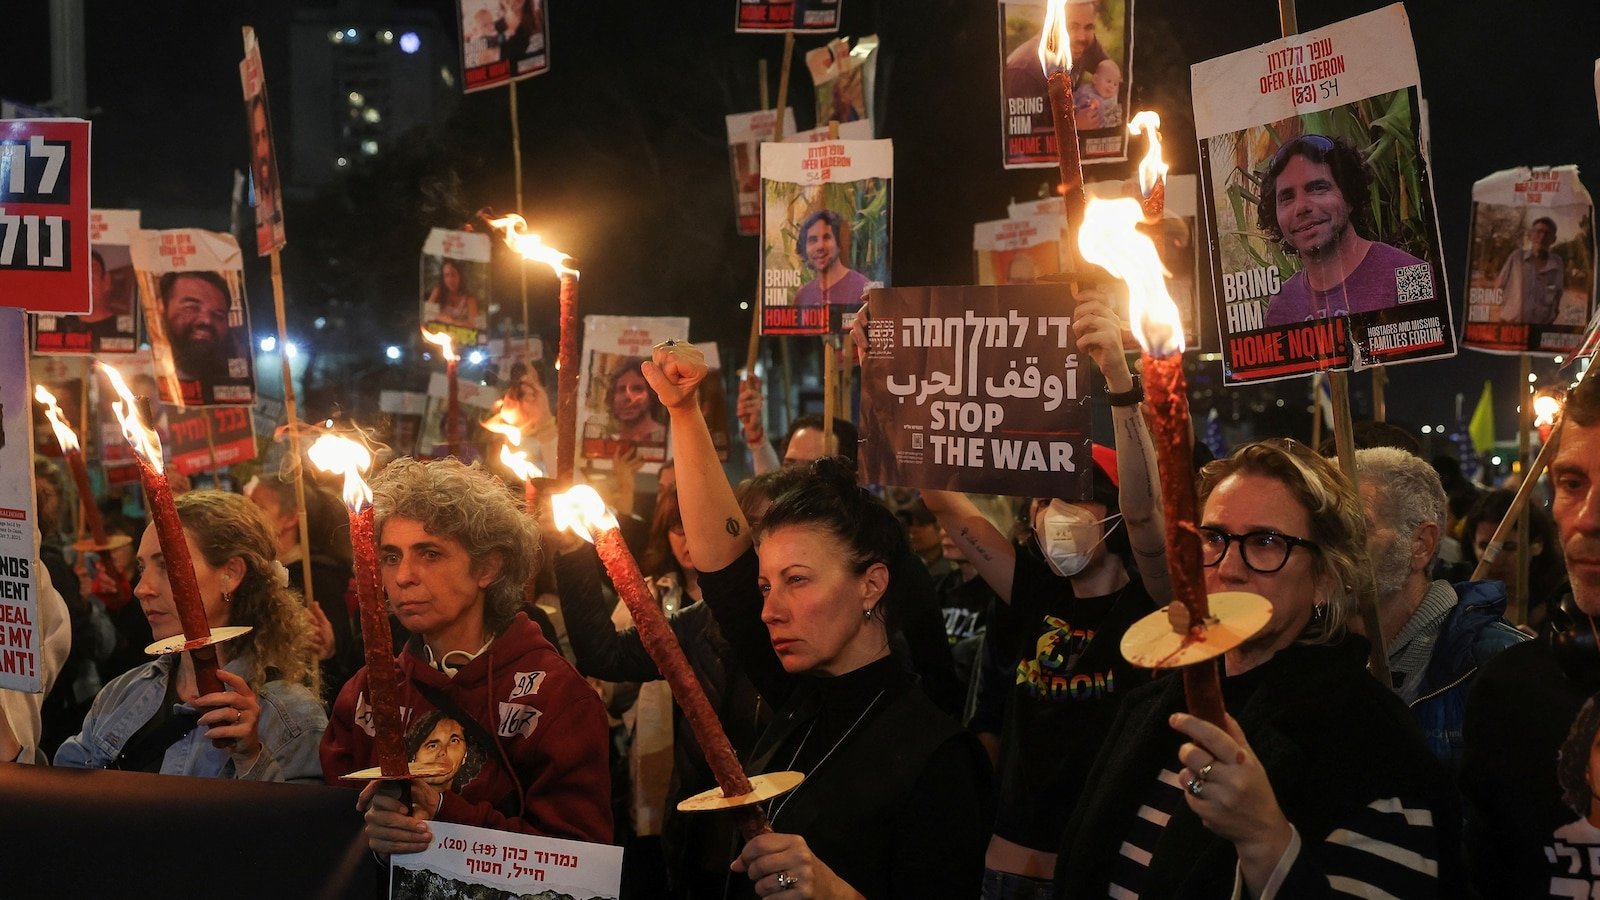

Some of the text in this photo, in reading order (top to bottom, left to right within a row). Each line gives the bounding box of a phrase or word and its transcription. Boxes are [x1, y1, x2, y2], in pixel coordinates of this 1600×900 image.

[1267, 38, 1333, 73] עופר קלדרון
[1260, 54, 1345, 94] OFER KALDERON
[1320, 78, 1339, 99] 54
[1008, 97, 1043, 115] BRING
[1009, 116, 1032, 135] HIM
[765, 269, 800, 287] BRING
[1223, 265, 1281, 303] BRING
[765, 287, 788, 306] HIM
[1470, 288, 1504, 305] BRING
[764, 308, 798, 327] HOME
[1226, 300, 1264, 334] HIM
[1367, 316, 1440, 338] HOSTAGES AND MISSING
[902, 310, 1071, 349] די למלחמה
[1368, 327, 1443, 352] FAMILIES FORUM
[1230, 319, 1345, 368] HOME NOW!
[886, 350, 1079, 412] أوقف الحرب
[930, 400, 1005, 433] STOP
[930, 435, 1076, 473] THE WAR
[9, 626, 32, 649] MY
[512, 672, 541, 696] 98
[500, 706, 537, 734] 167
[471, 841, 498, 858] (19)
[502, 846, 528, 862] כהן
[534, 849, 578, 868] נמרוד
[466, 858, 545, 882] חייל, חטוף
